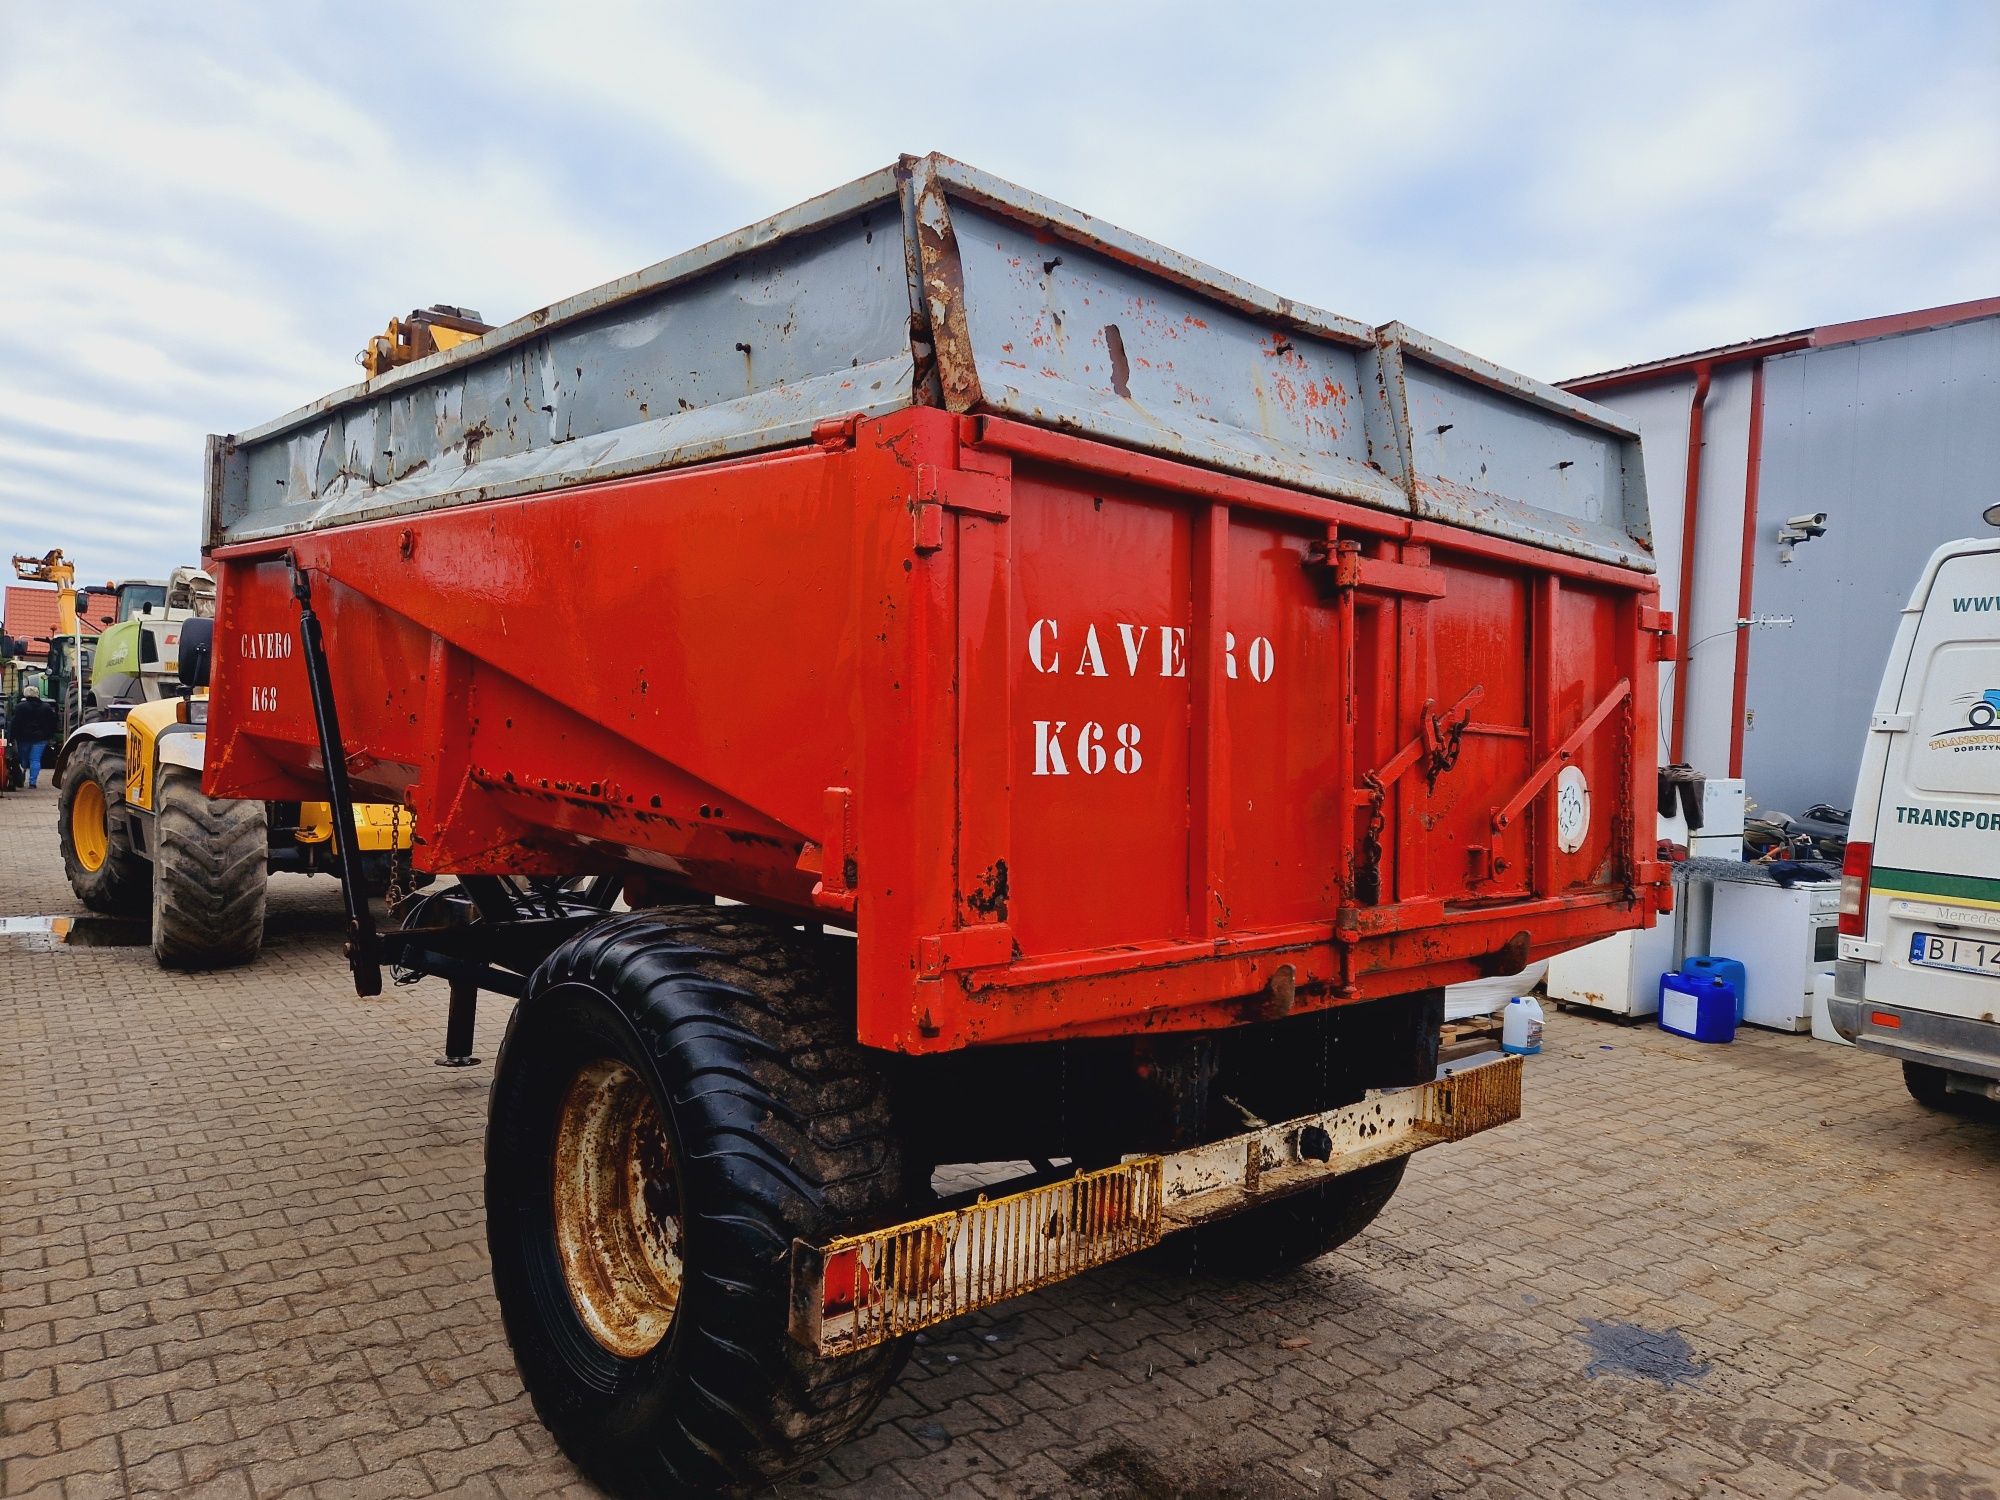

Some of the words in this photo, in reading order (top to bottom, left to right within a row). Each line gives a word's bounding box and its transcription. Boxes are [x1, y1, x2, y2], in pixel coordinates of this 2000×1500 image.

[241, 632, 292, 659] CAVERO
[252, 686, 277, 712] K68
[128, 730, 142, 781] JCB
[1032, 720, 1143, 775] K68
[1913, 949, 1923, 957] PL
